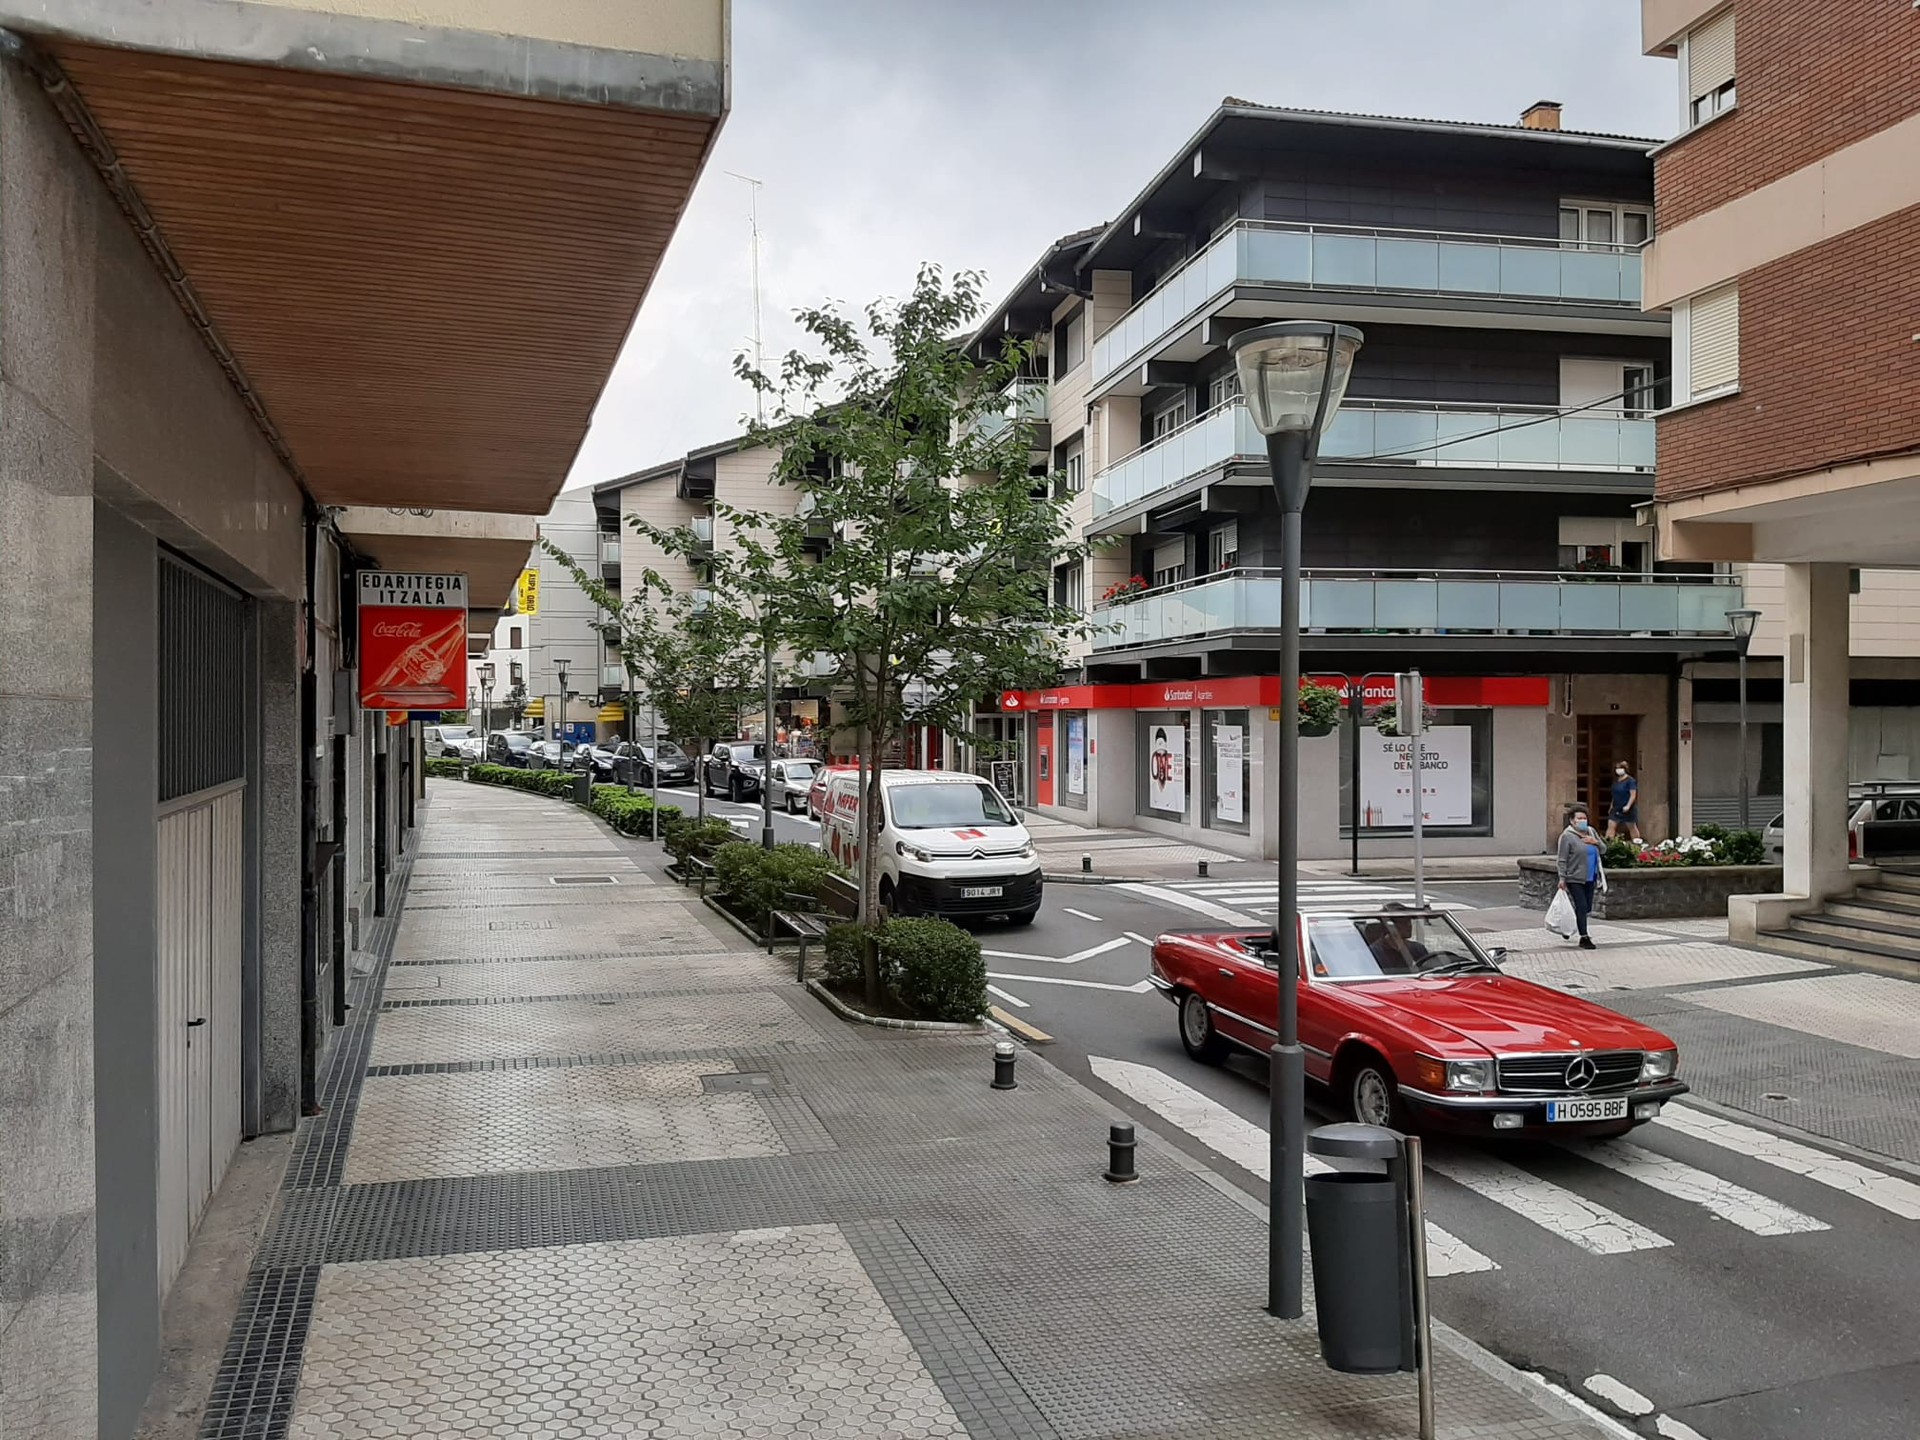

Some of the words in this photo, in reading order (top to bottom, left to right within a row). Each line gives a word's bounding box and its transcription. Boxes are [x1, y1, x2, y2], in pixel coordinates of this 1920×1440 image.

[362, 574, 462, 590] EDARITEGIA
[380, 590, 445, 604] ITZALA
[373, 622, 423, 637] Coca-Cola
[1383, 743, 1393, 752] SÉ
[1395, 744, 1406, 752] LO
[1408, 744, 1426, 752] QE
[1399, 752, 1439, 761] NESITO
[1394, 761, 1405, 770] DE
[1420, 761, 1448, 770] BANCO
[1558, 1103, 1567, 1119] H
[1570, 1102, 1602, 1119] 0595
[1604, 1100, 1626, 1117] BBF
